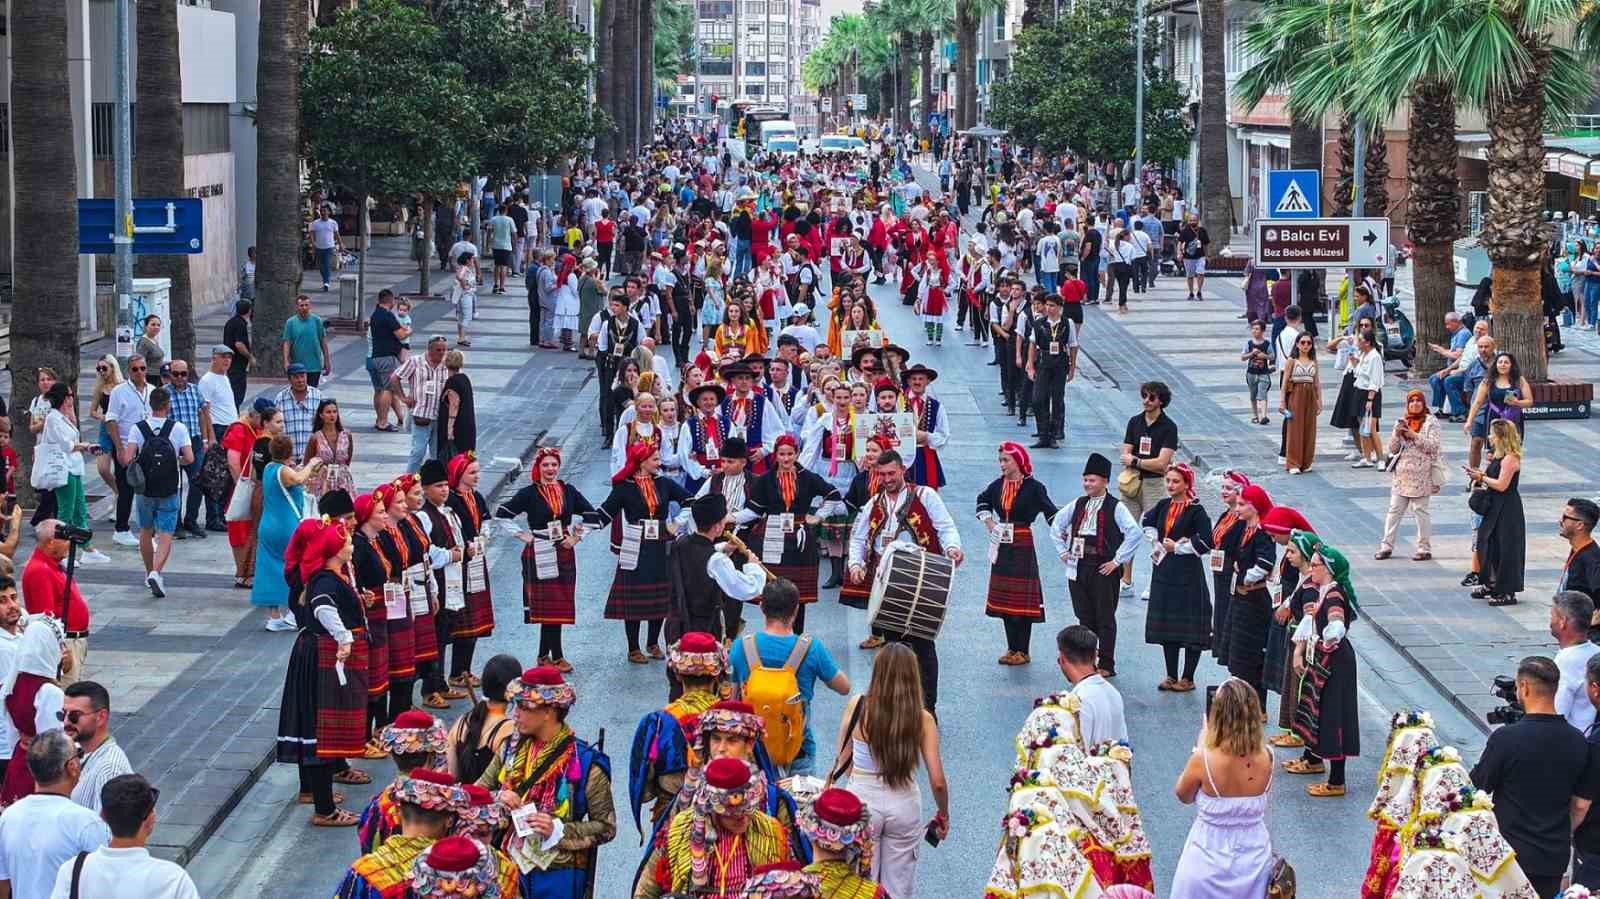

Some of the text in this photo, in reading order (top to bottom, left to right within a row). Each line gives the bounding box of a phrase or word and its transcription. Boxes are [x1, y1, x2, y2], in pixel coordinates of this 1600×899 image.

[1281, 229, 1340, 241] Balcı Evi
[1264, 247, 1344, 257] Bez Bebek Müzesi
